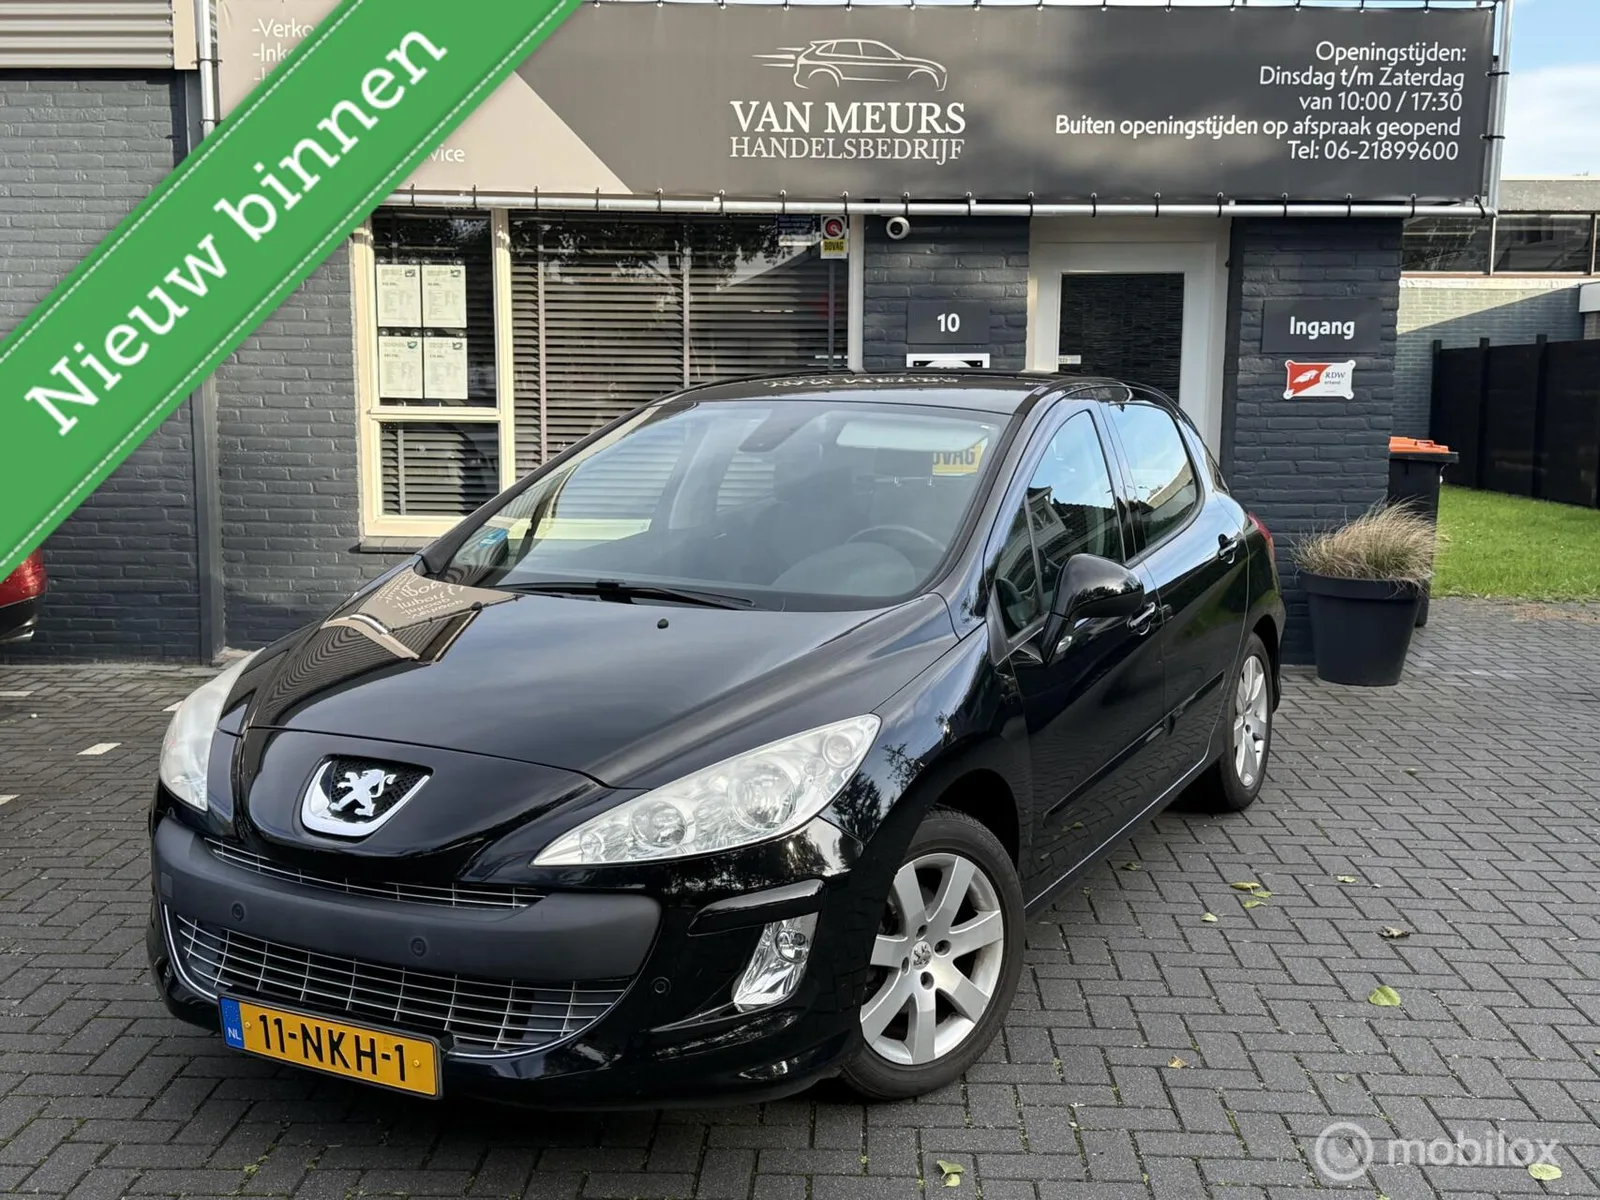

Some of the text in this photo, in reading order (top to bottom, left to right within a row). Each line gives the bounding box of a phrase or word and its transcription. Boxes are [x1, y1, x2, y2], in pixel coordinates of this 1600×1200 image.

[252, 17, 314, 38] -Verko
[1315, 40, 1467, 67] Openingstijden:
[1259, 66, 1465, 91] Dinsdag t/m Zaterdag
[1299, 90, 1463, 112] van 10:00 / 17:30
[729, 100, 966, 134] VAN MEURS
[1055, 114, 1461, 140] Buiten openingstijden op afspraak geopend
[430, 143, 466, 162] vice
[729, 136, 965, 166] HANDELSBEDRIJF
[1287, 140, 1459, 160] Tel: 06-21899600
[937, 313, 961, 332] 10
[1289, 316, 1355, 340] Ingang
[1324, 371, 1346, 379] RDW
[227, 1026, 242, 1041] NL
[258, 1014, 406, 1082] 11-NKH-1
